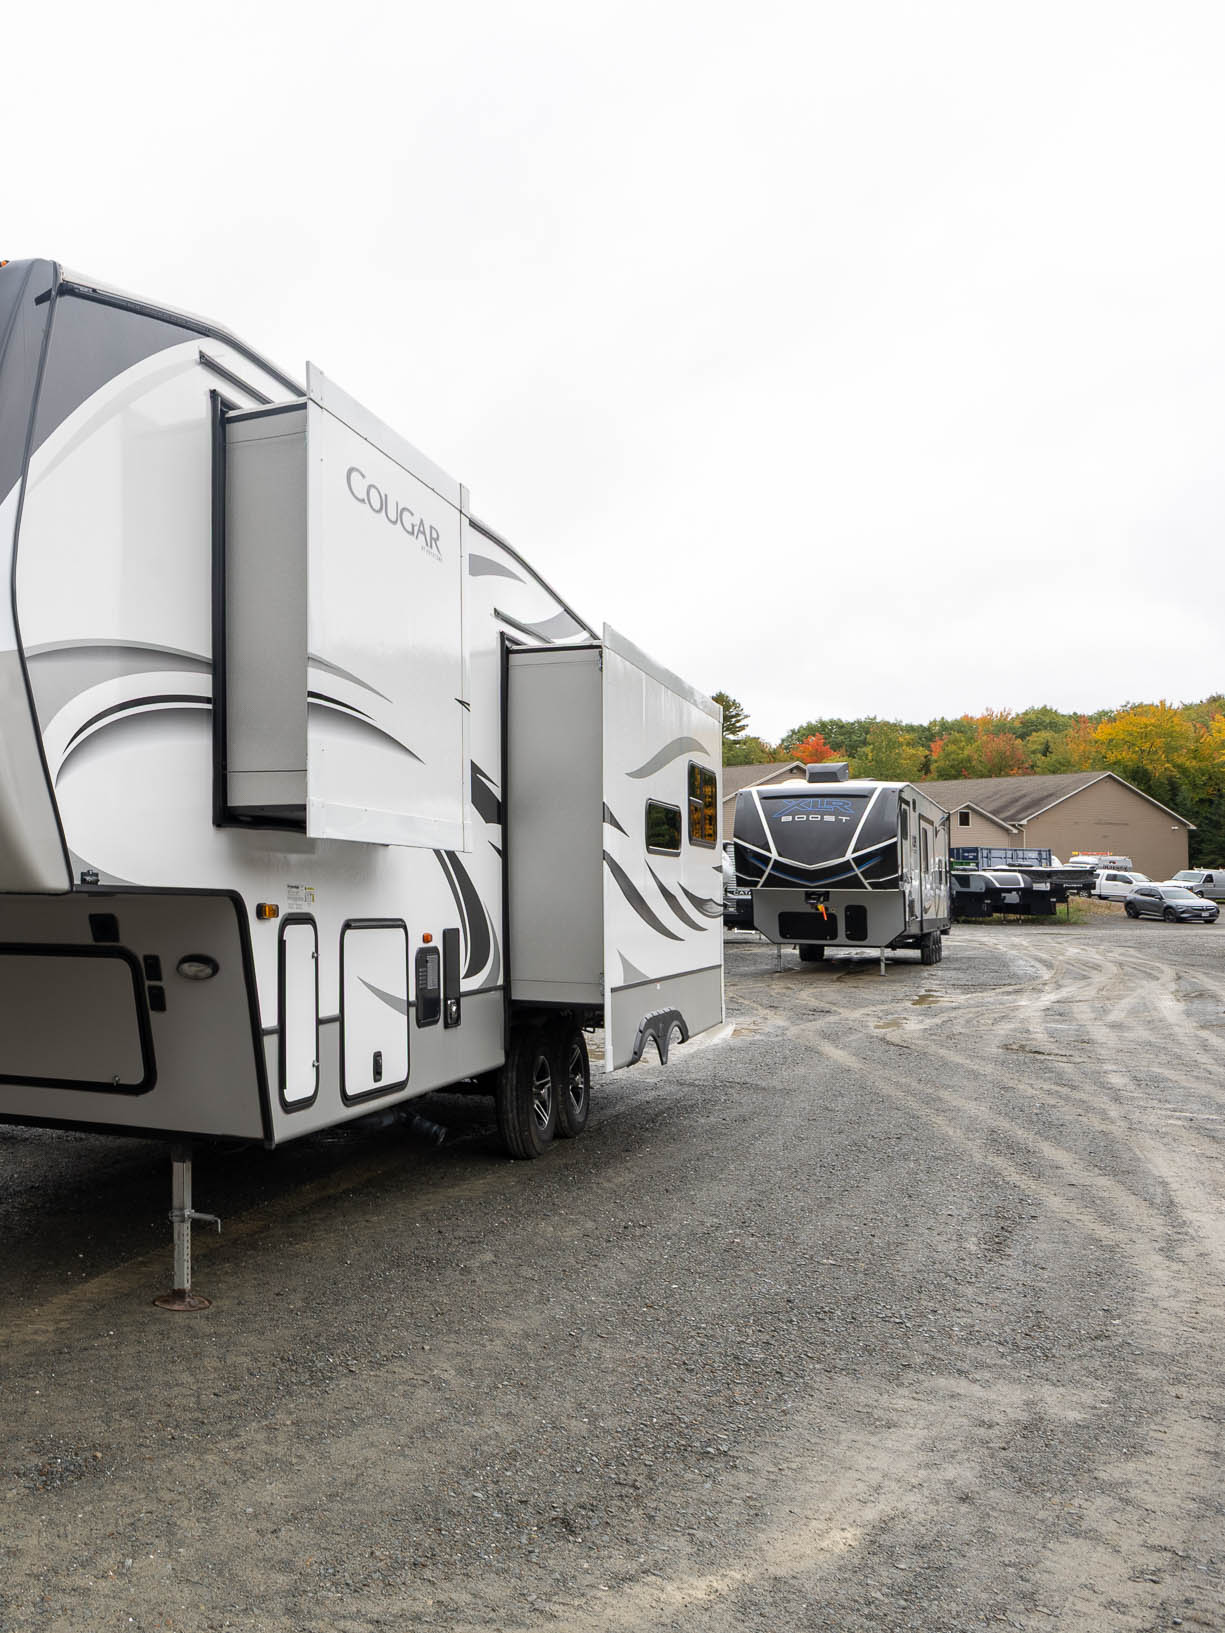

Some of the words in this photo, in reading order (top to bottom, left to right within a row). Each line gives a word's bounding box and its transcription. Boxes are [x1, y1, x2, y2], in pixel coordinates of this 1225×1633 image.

[345, 465, 443, 556] COUGAR
[772, 799, 856, 818] XLR
[780, 814, 851, 823] BOOST
